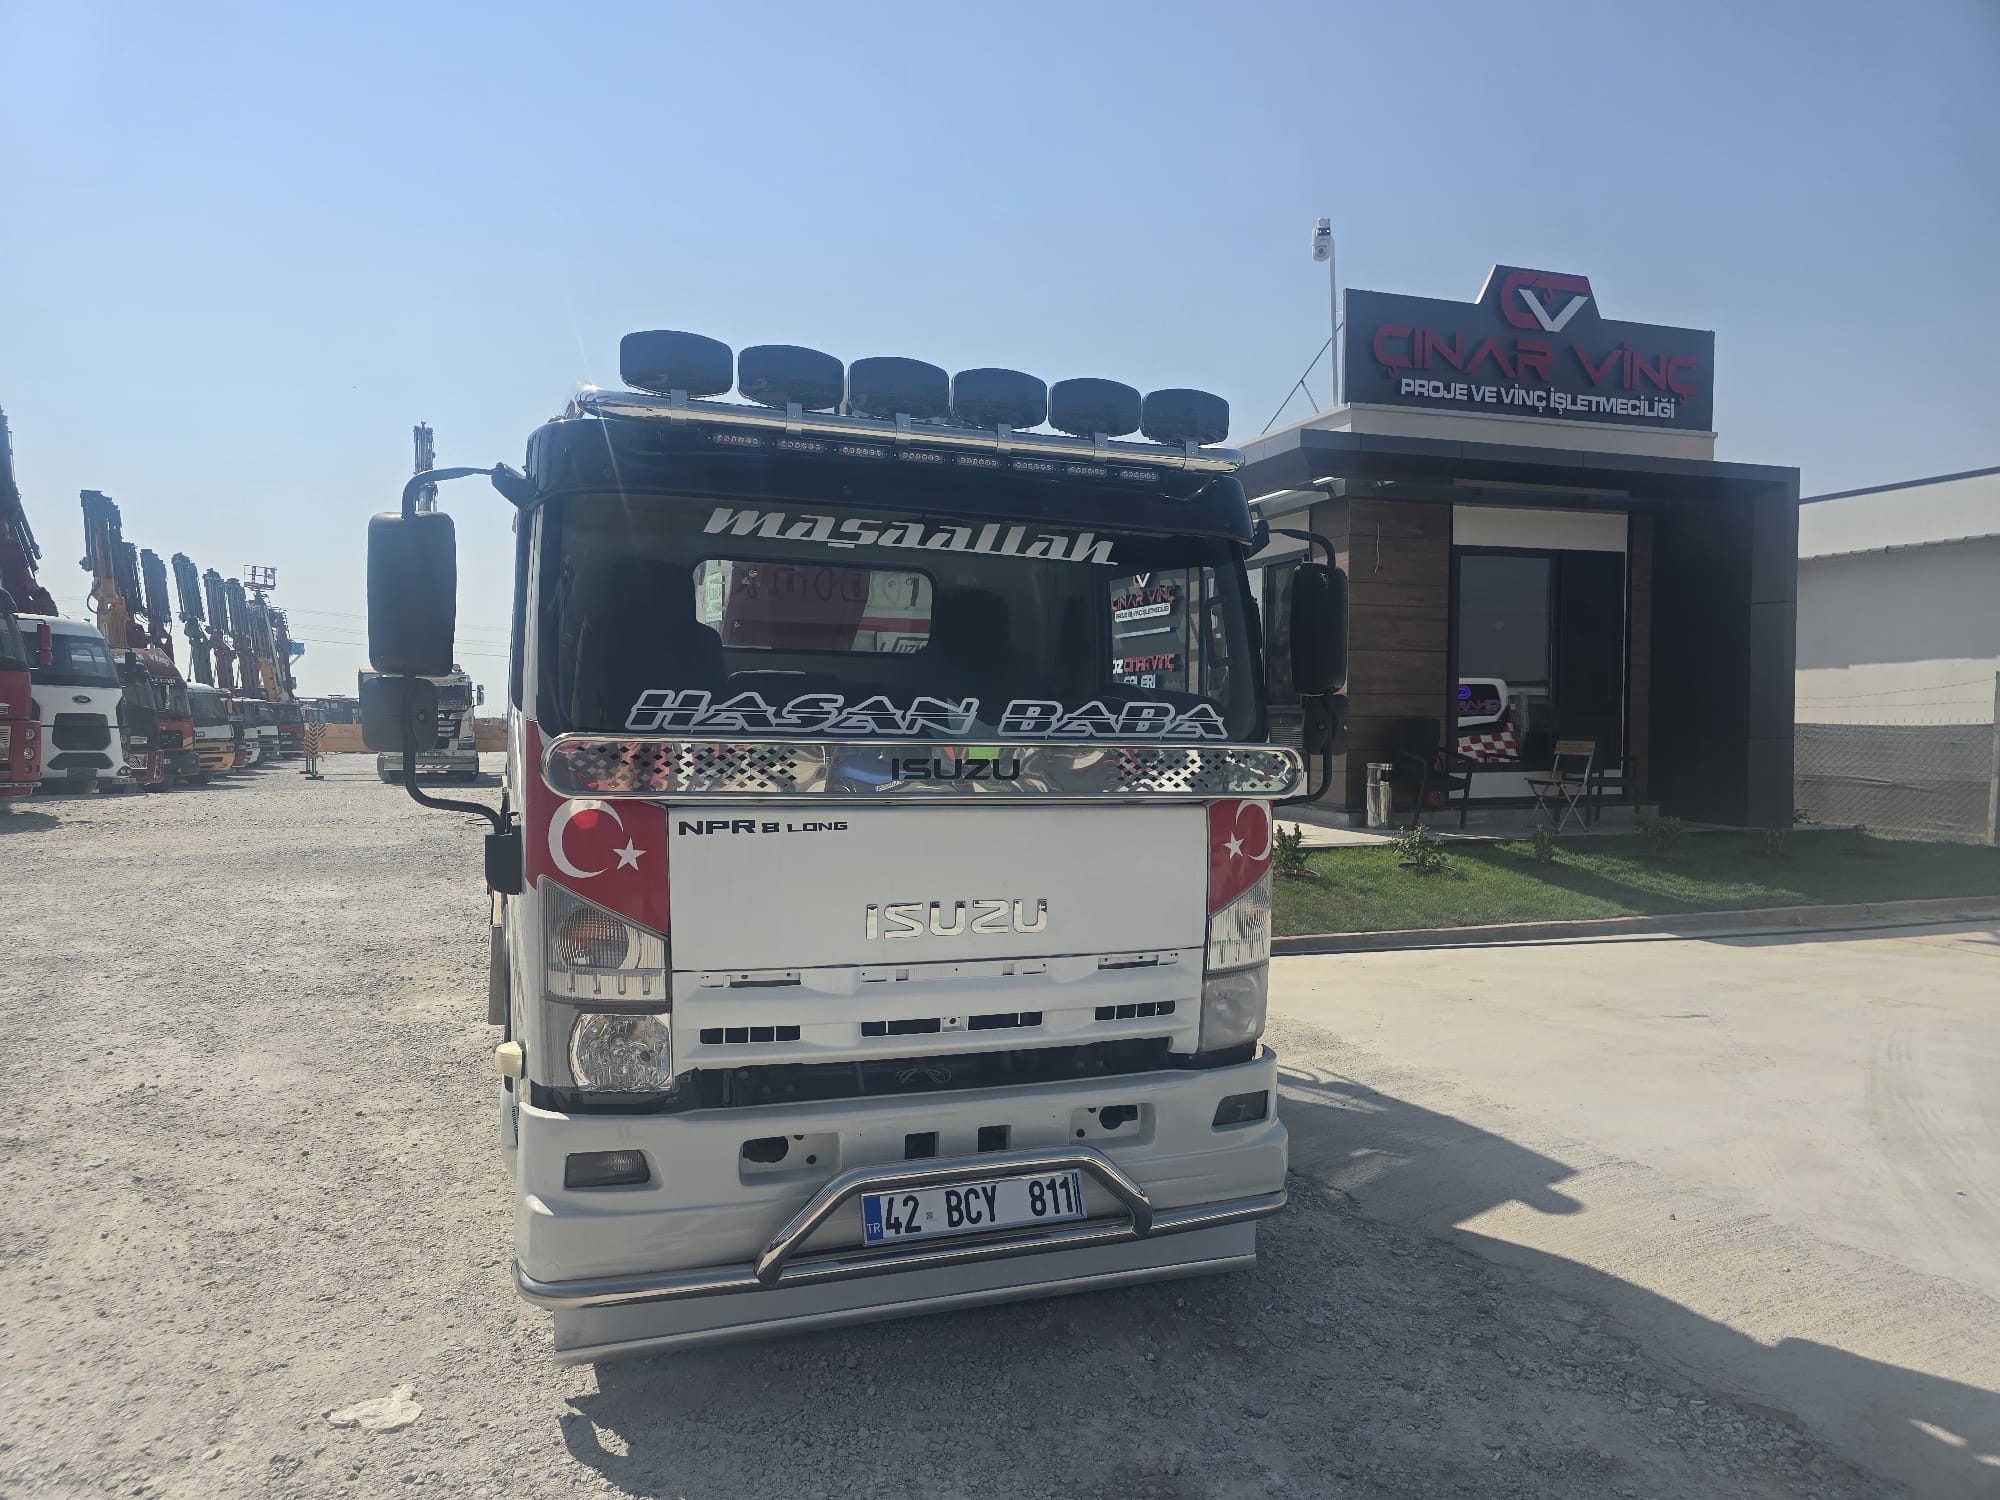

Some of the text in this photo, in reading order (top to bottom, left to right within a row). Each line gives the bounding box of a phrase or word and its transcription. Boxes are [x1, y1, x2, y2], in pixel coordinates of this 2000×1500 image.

[1373, 323, 1697, 405] ÇINAR VİNÇ
[1400, 378, 1675, 419] PROJE VE VİNÇ İŞLETMECİLİĞİ
[625, 689, 1229, 739] HASAN BABA
[892, 758, 1020, 781] ISUZU
[678, 819, 756, 836] NPR
[787, 821, 849, 834] LONG
[865, 898, 1048, 941] ISUZU
[885, 1176, 1074, 1235] 42 BCY 811
[866, 1223, 881, 1234] TR
